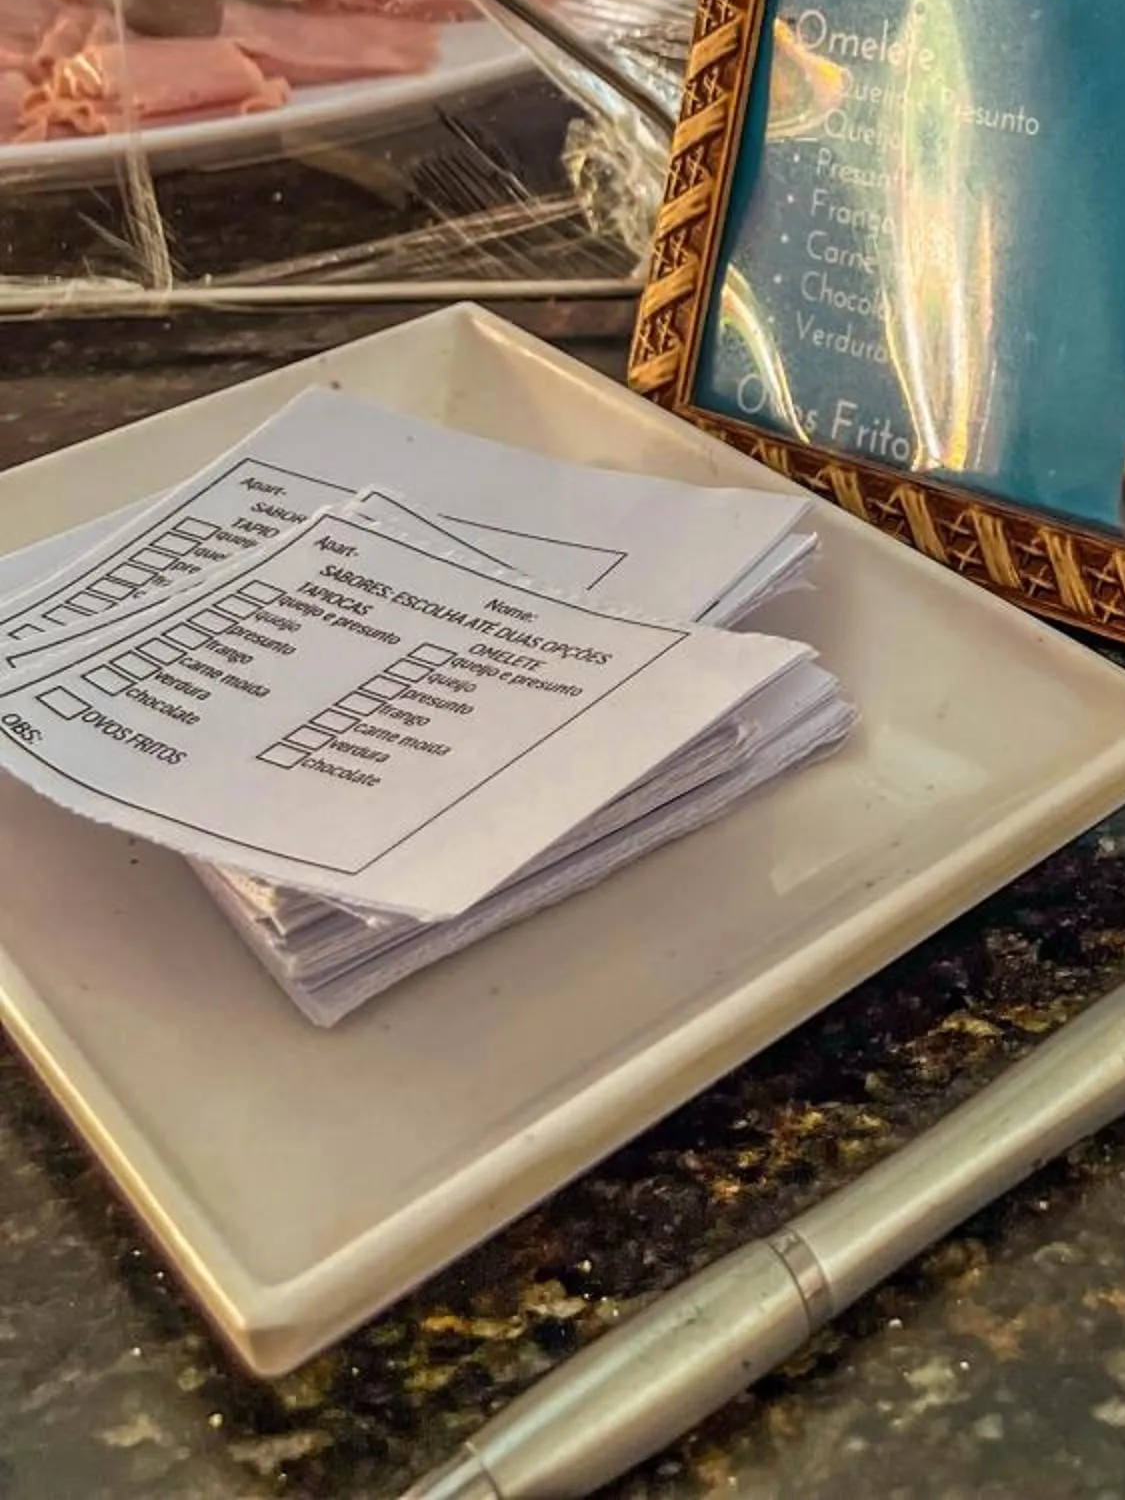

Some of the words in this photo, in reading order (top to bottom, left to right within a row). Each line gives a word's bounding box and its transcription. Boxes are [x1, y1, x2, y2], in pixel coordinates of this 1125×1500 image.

[297, 581, 374, 617] TAPIOCAS
[391, 591, 468, 629] ESCOLHA
[496, 626, 541, 649] DUAS
[81, 708, 135, 742] OVOS
[126, 732, 188, 766] FRITOS
